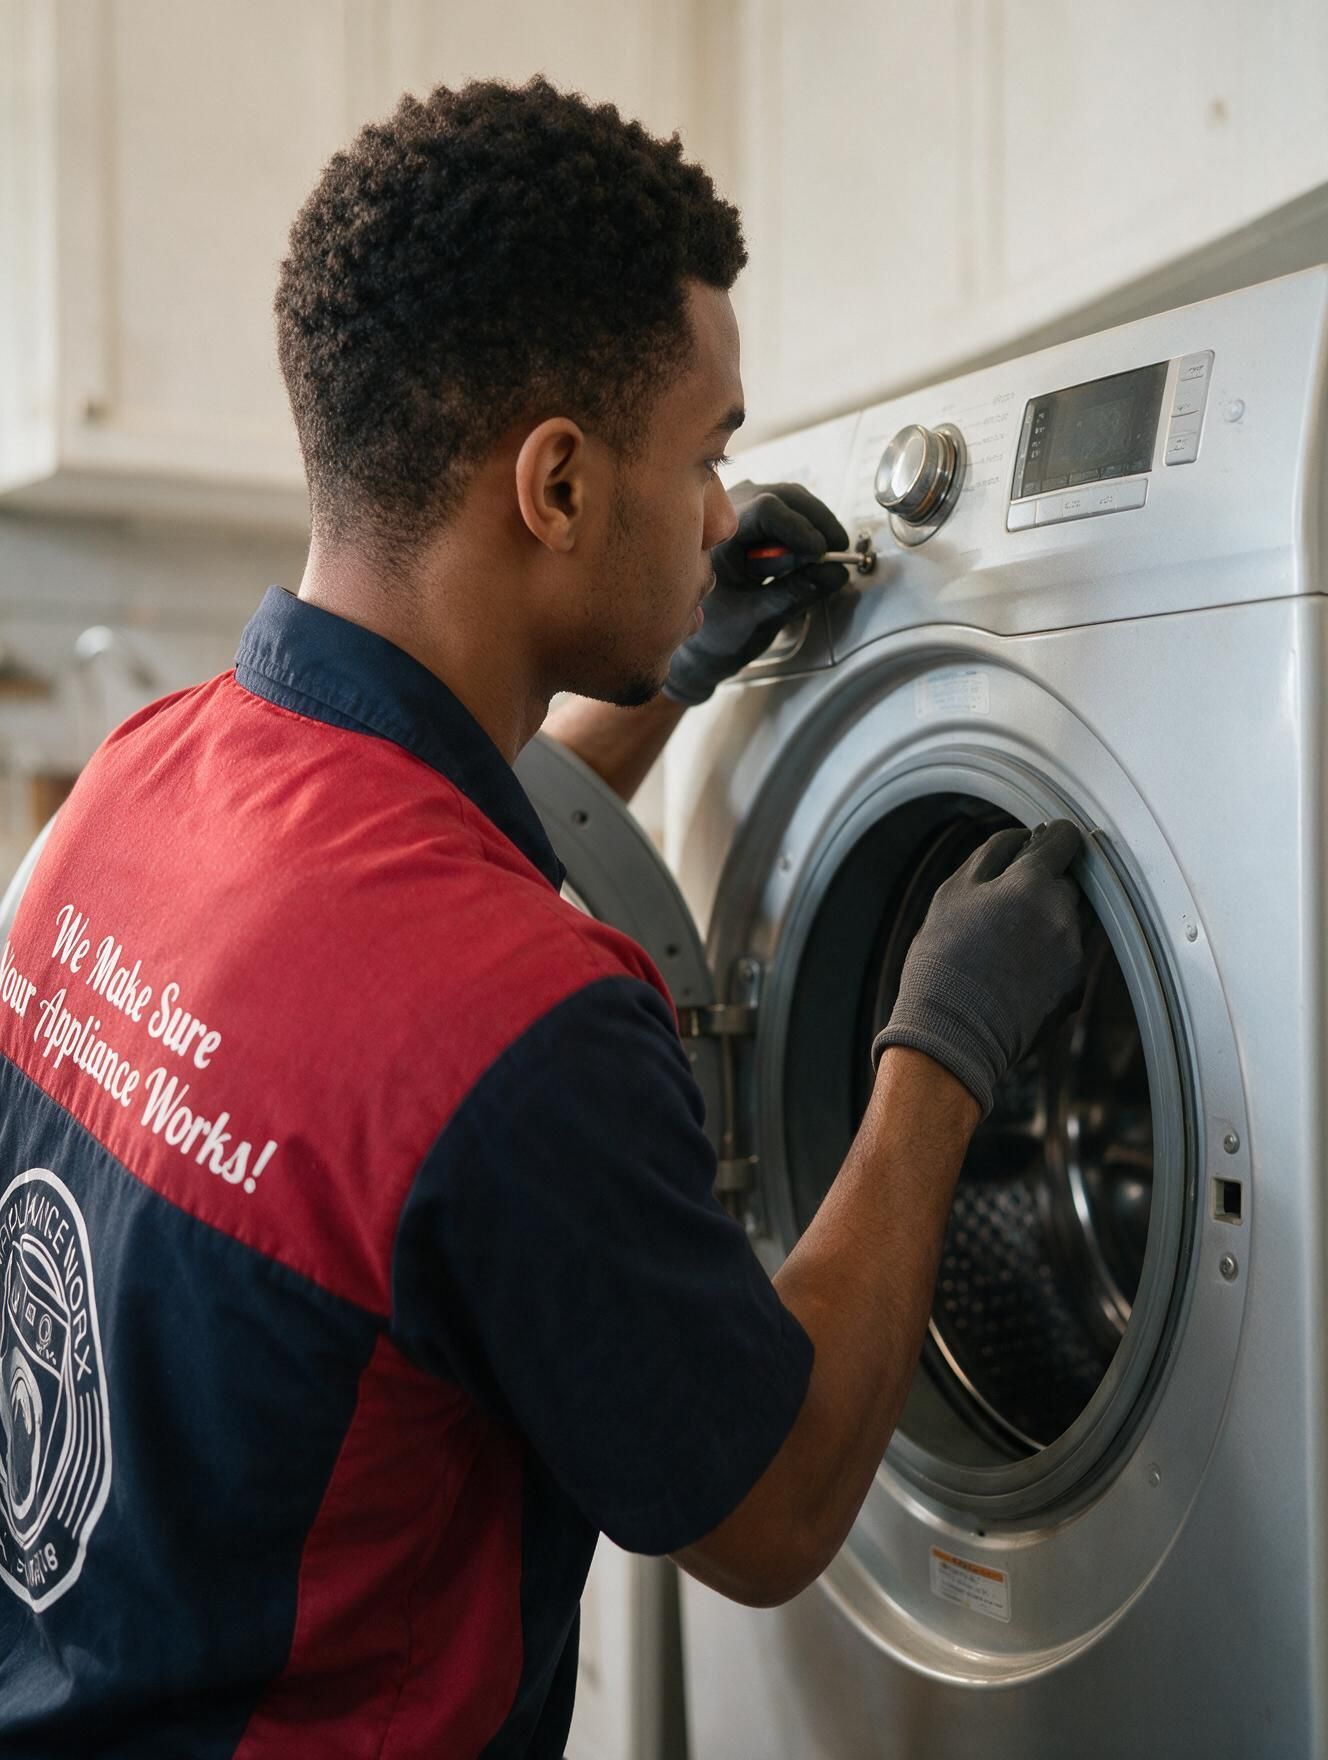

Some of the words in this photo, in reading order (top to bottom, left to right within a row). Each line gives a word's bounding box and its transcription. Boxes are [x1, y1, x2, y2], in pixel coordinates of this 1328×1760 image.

[52, 904, 90, 973] We
[86, 935, 152, 1022] Make
[148, 982, 222, 1069] Sure
[33, 988, 140, 1107] Appliance
[140, 1066, 278, 1194] Works!
